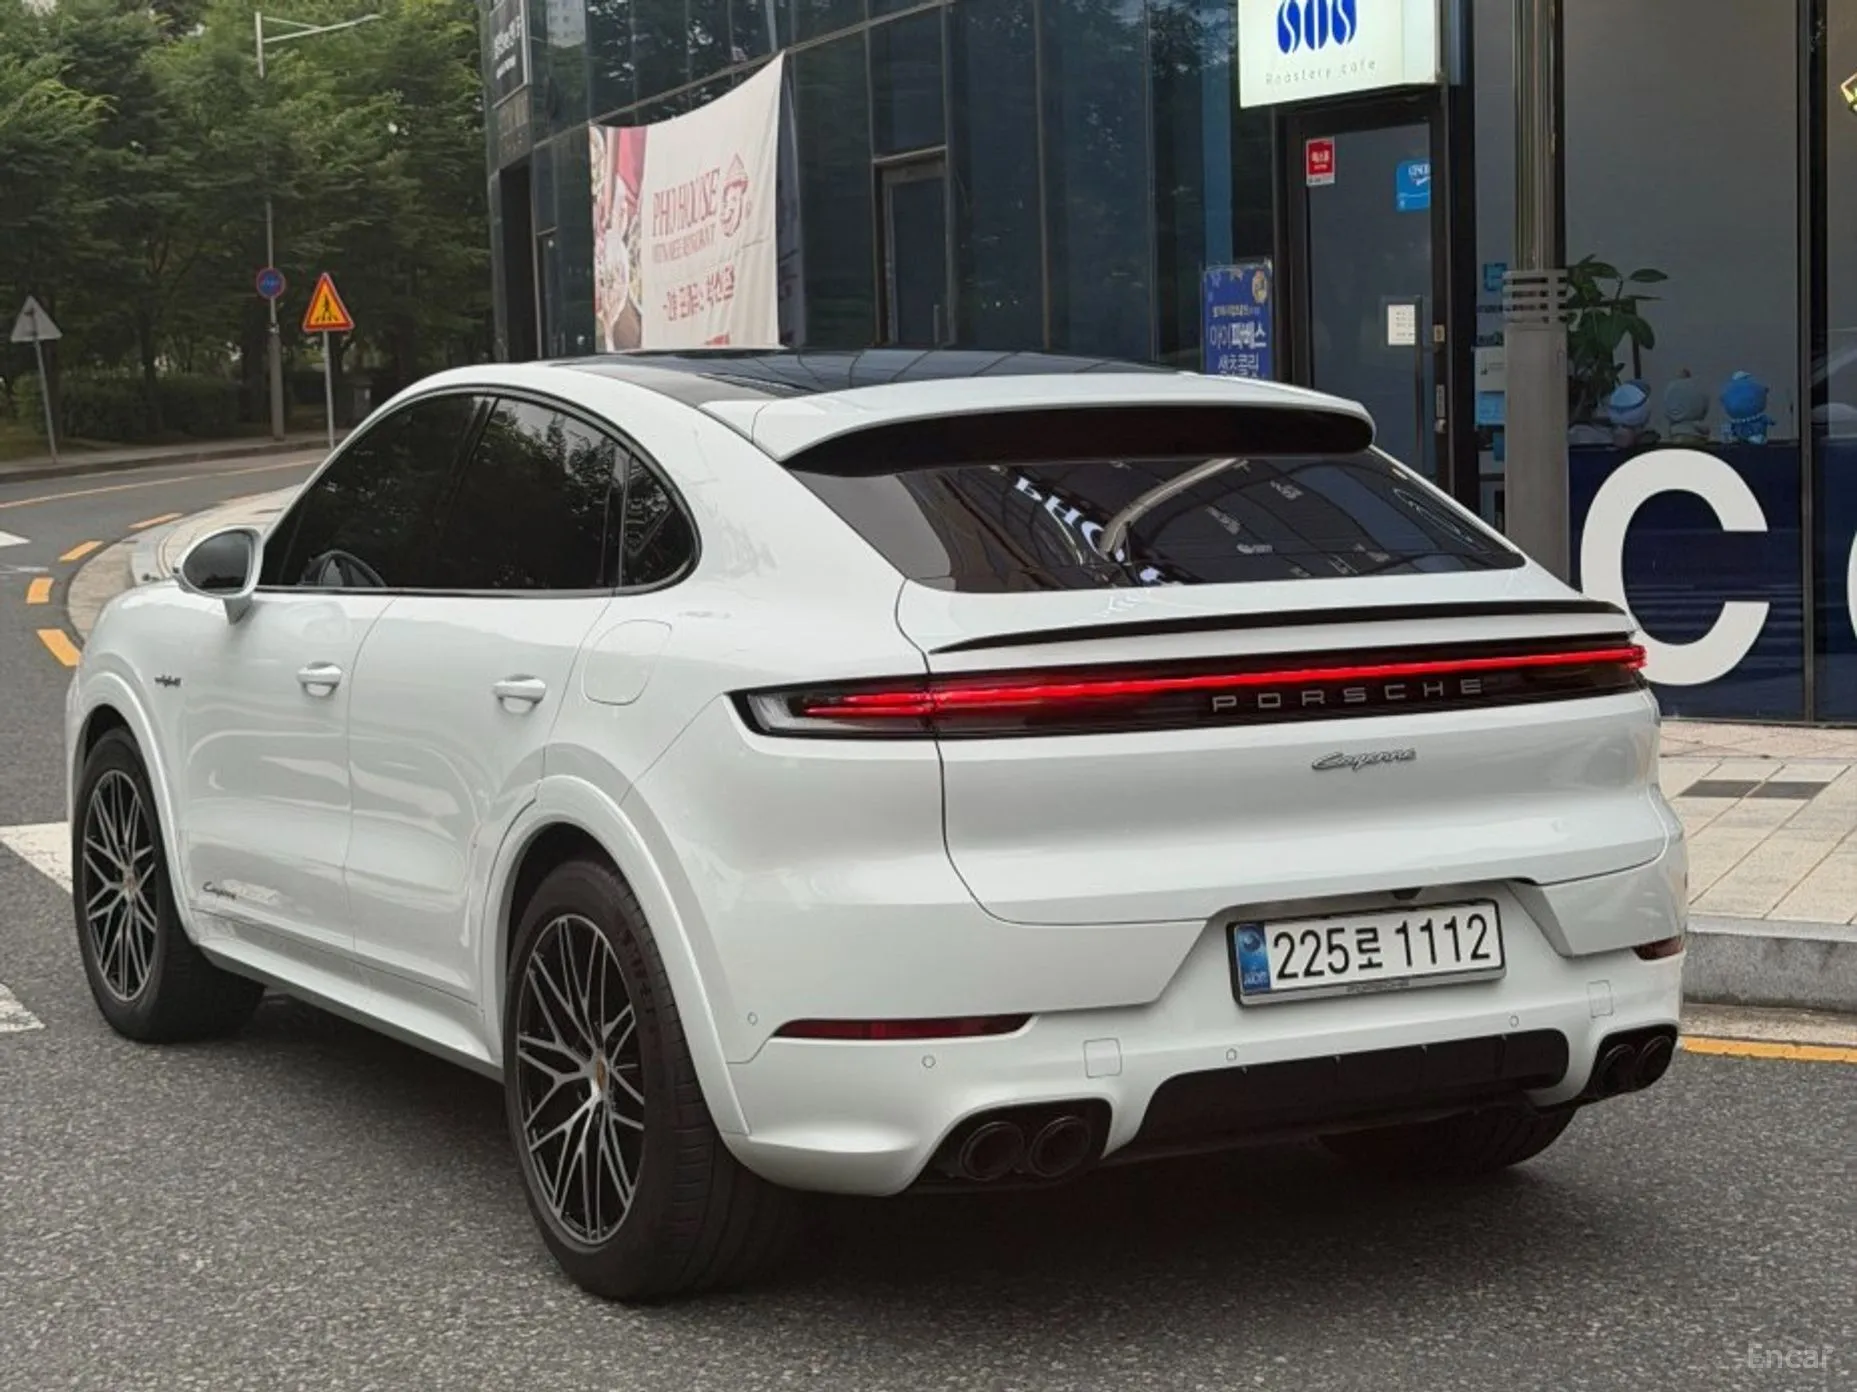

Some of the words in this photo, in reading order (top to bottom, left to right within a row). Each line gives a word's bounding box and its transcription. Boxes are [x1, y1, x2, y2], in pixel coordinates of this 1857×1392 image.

[1212, 679, 1484, 712] PORSCHE
[1311, 747, 1416, 771] Cayenne
[1273, 927, 1383, 980] 225로
[1395, 913, 1491, 968] 1112
